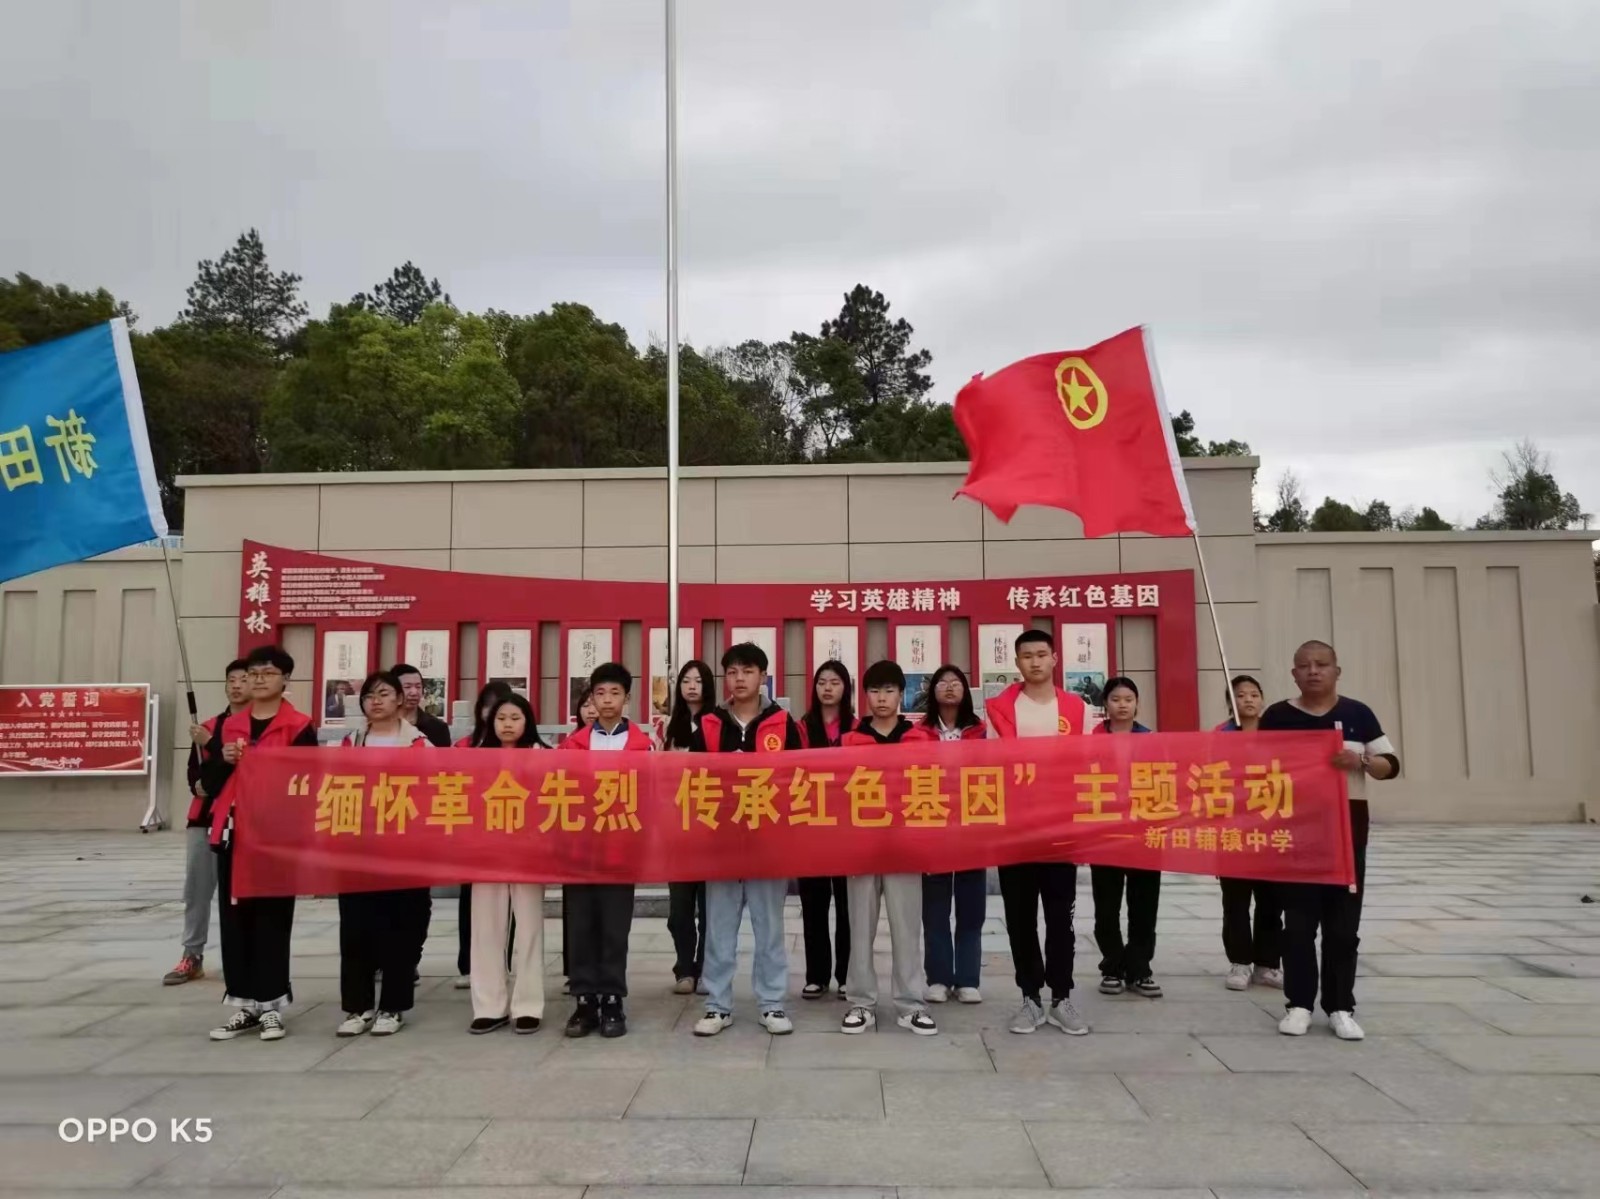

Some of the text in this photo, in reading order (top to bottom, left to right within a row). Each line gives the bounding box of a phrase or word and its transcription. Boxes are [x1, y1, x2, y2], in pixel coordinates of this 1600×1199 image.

[244, 551, 273, 634] 英雄林
[810, 584, 1160, 612] 学习英雄精神 传承红色基因
[17, 691, 100, 708] 入党誓词
[1073, 759, 1294, 823] 主题活动
